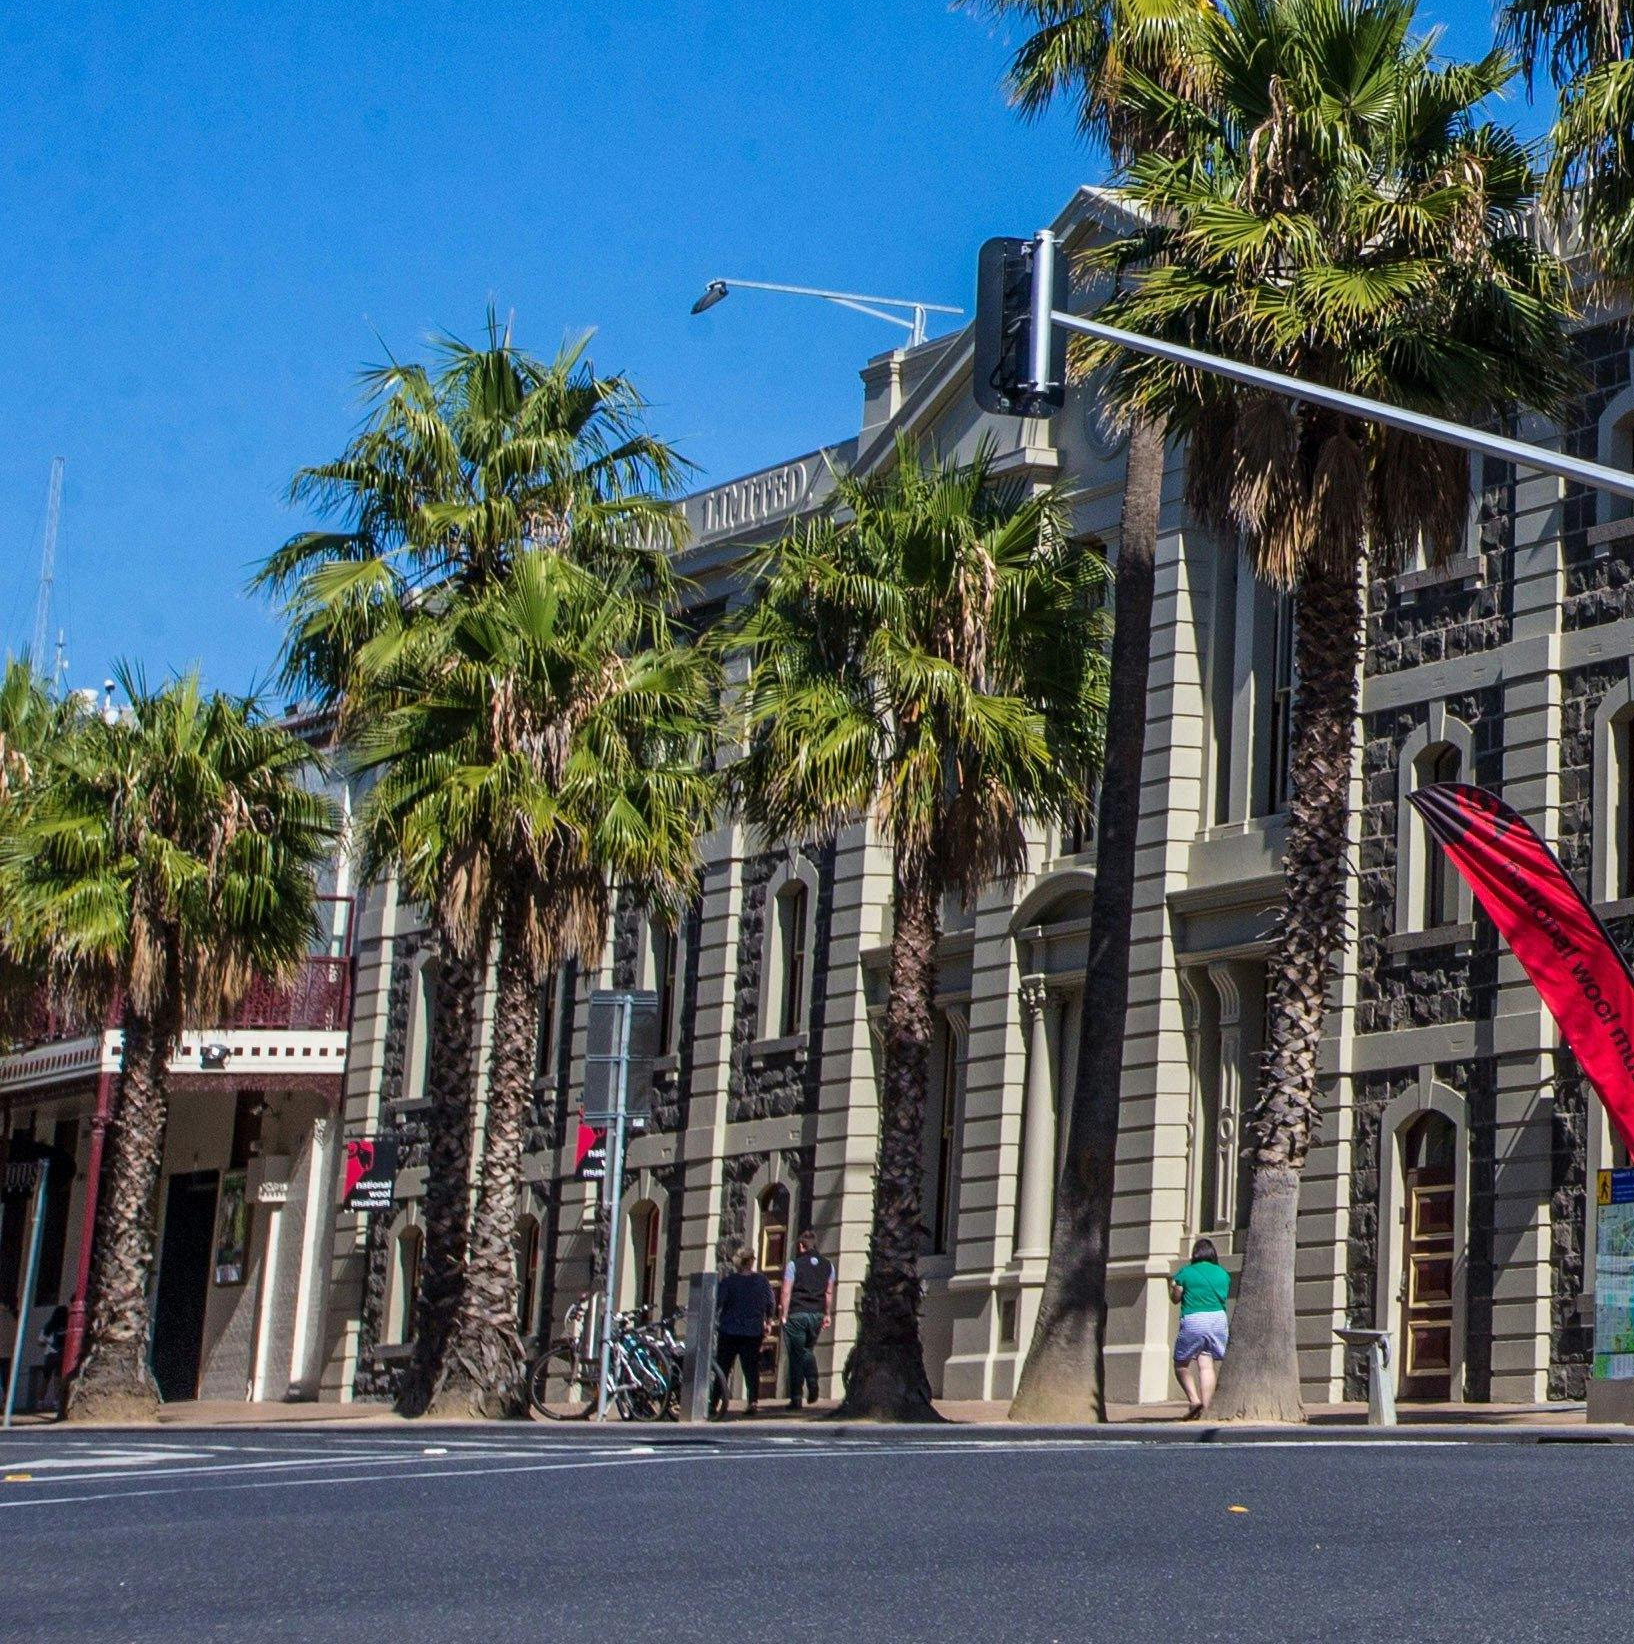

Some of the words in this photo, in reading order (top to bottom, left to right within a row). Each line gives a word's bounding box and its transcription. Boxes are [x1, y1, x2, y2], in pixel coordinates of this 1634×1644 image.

[1503, 861, 1580, 960] national
[1571, 961, 1622, 1025] wool
[368, 1190, 391, 1199] wool
